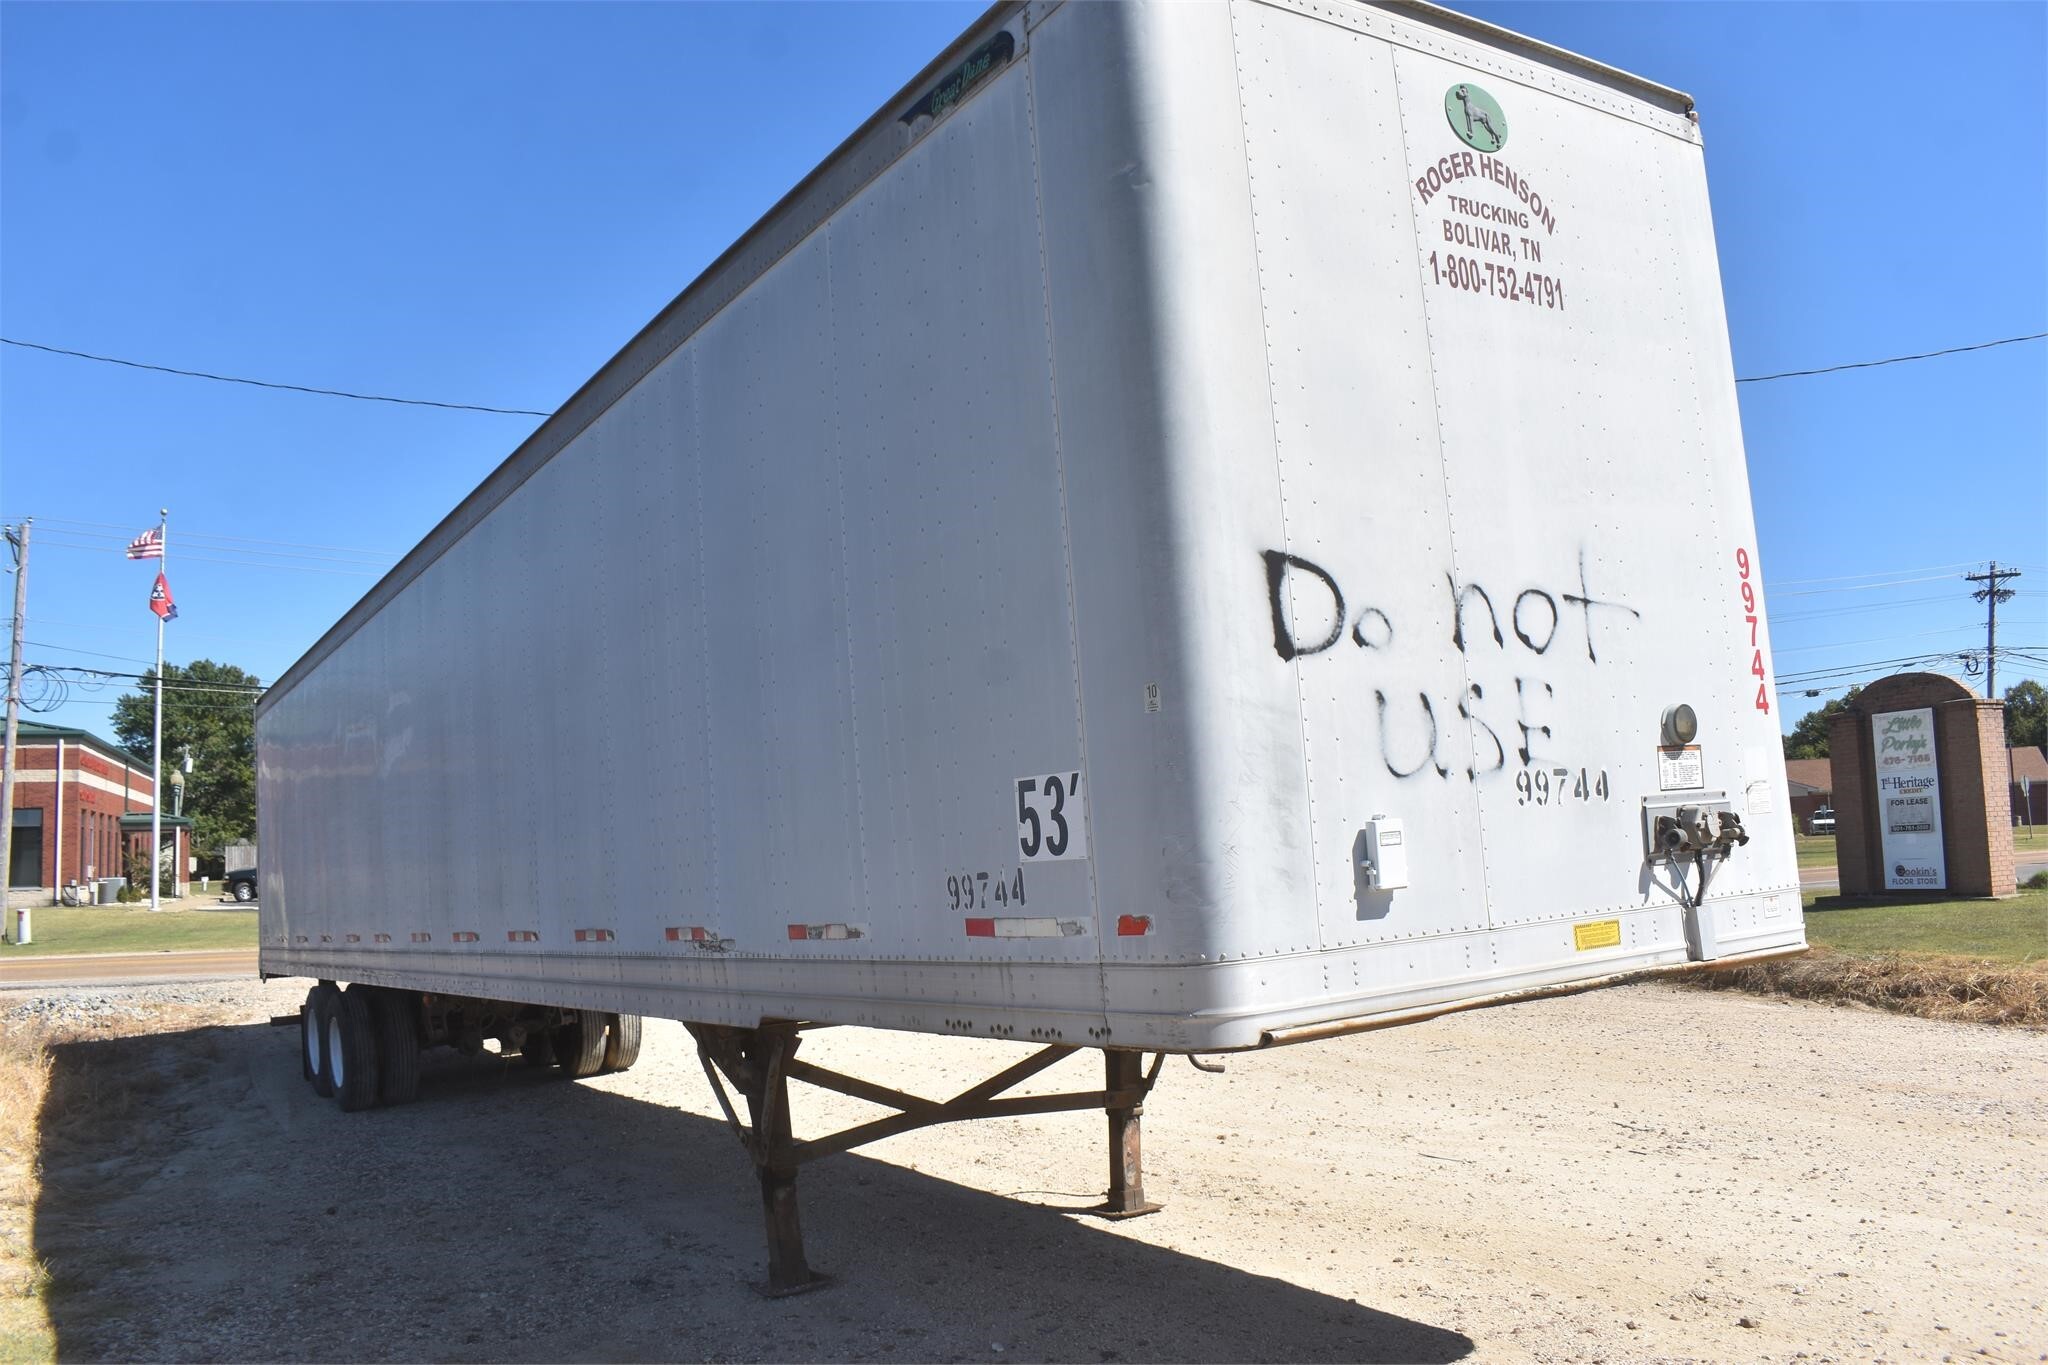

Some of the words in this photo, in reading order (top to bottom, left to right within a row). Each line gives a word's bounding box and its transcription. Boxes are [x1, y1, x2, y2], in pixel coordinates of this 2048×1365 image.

[1415, 151, 1477, 205] ROGER
[1479, 153, 1556, 236] HENSON
[1447, 194, 1529, 229] TRUCKING
[1442, 219, 1517, 262] BOLIVAR,
[1520, 237, 1541, 263] TN
[1429, 250, 1564, 311] 1-800-752-4791
[1260, 549, 1393, 663] Do
[1445, 545, 1640, 664] not
[1736, 547, 1770, 716] 99744
[1515, 767, 1609, 806] 99744
[1893, 775, 1935, 789] Heritage
[1906, 798, 1929, 806] LEASE
[947, 867, 1027, 911] 99744
